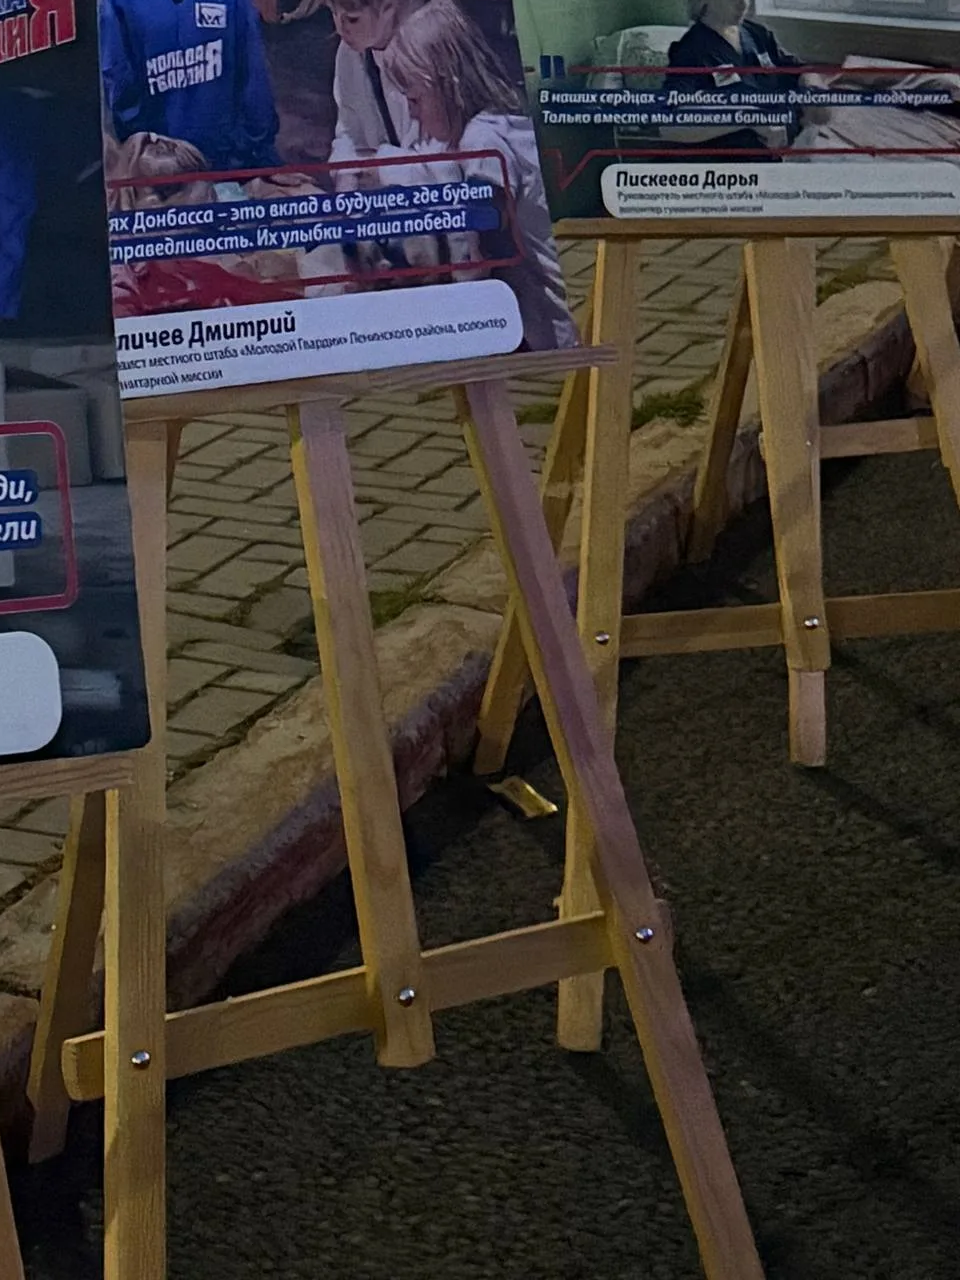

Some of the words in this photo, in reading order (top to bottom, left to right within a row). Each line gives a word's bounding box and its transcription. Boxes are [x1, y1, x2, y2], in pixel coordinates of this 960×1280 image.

[540, 90, 548, 103] В
[552, 93, 596, 104] наших
[599, 90, 655, 106] сердцах
[730, 94, 738, 103] в
[741, 93, 785, 103] наших
[788, 90, 861, 104] действиях
[874, 90, 952, 106] поддержка.
[542, 110, 591, 124] Только
[594, 113, 649, 123] вместе
[651, 113, 673, 123] мы
[676, 113, 731, 123] сможем
[735, 111, 792, 124] больше!
[616, 171, 699, 187] Пискеева
[702, 170, 758, 190] Дарья
[132, 207, 214, 233] Донбасса
[231, 205, 265, 221] это
[270, 196, 318, 217] вклад
[322, 199, 332, 213] в
[335, 192, 409, 215] будущее,
[413, 186, 439, 204] где
[442, 182, 492, 206] будет
[256, 227, 278, 247] Их
[282, 223, 341, 248] улыбки
[357, 220, 401, 237] наша
[405, 211, 466, 233] победа!
[189, 311, 296, 348] Дмитрий
[149, 352, 202, 368] местного
[204, 346, 238, 361] штаба
